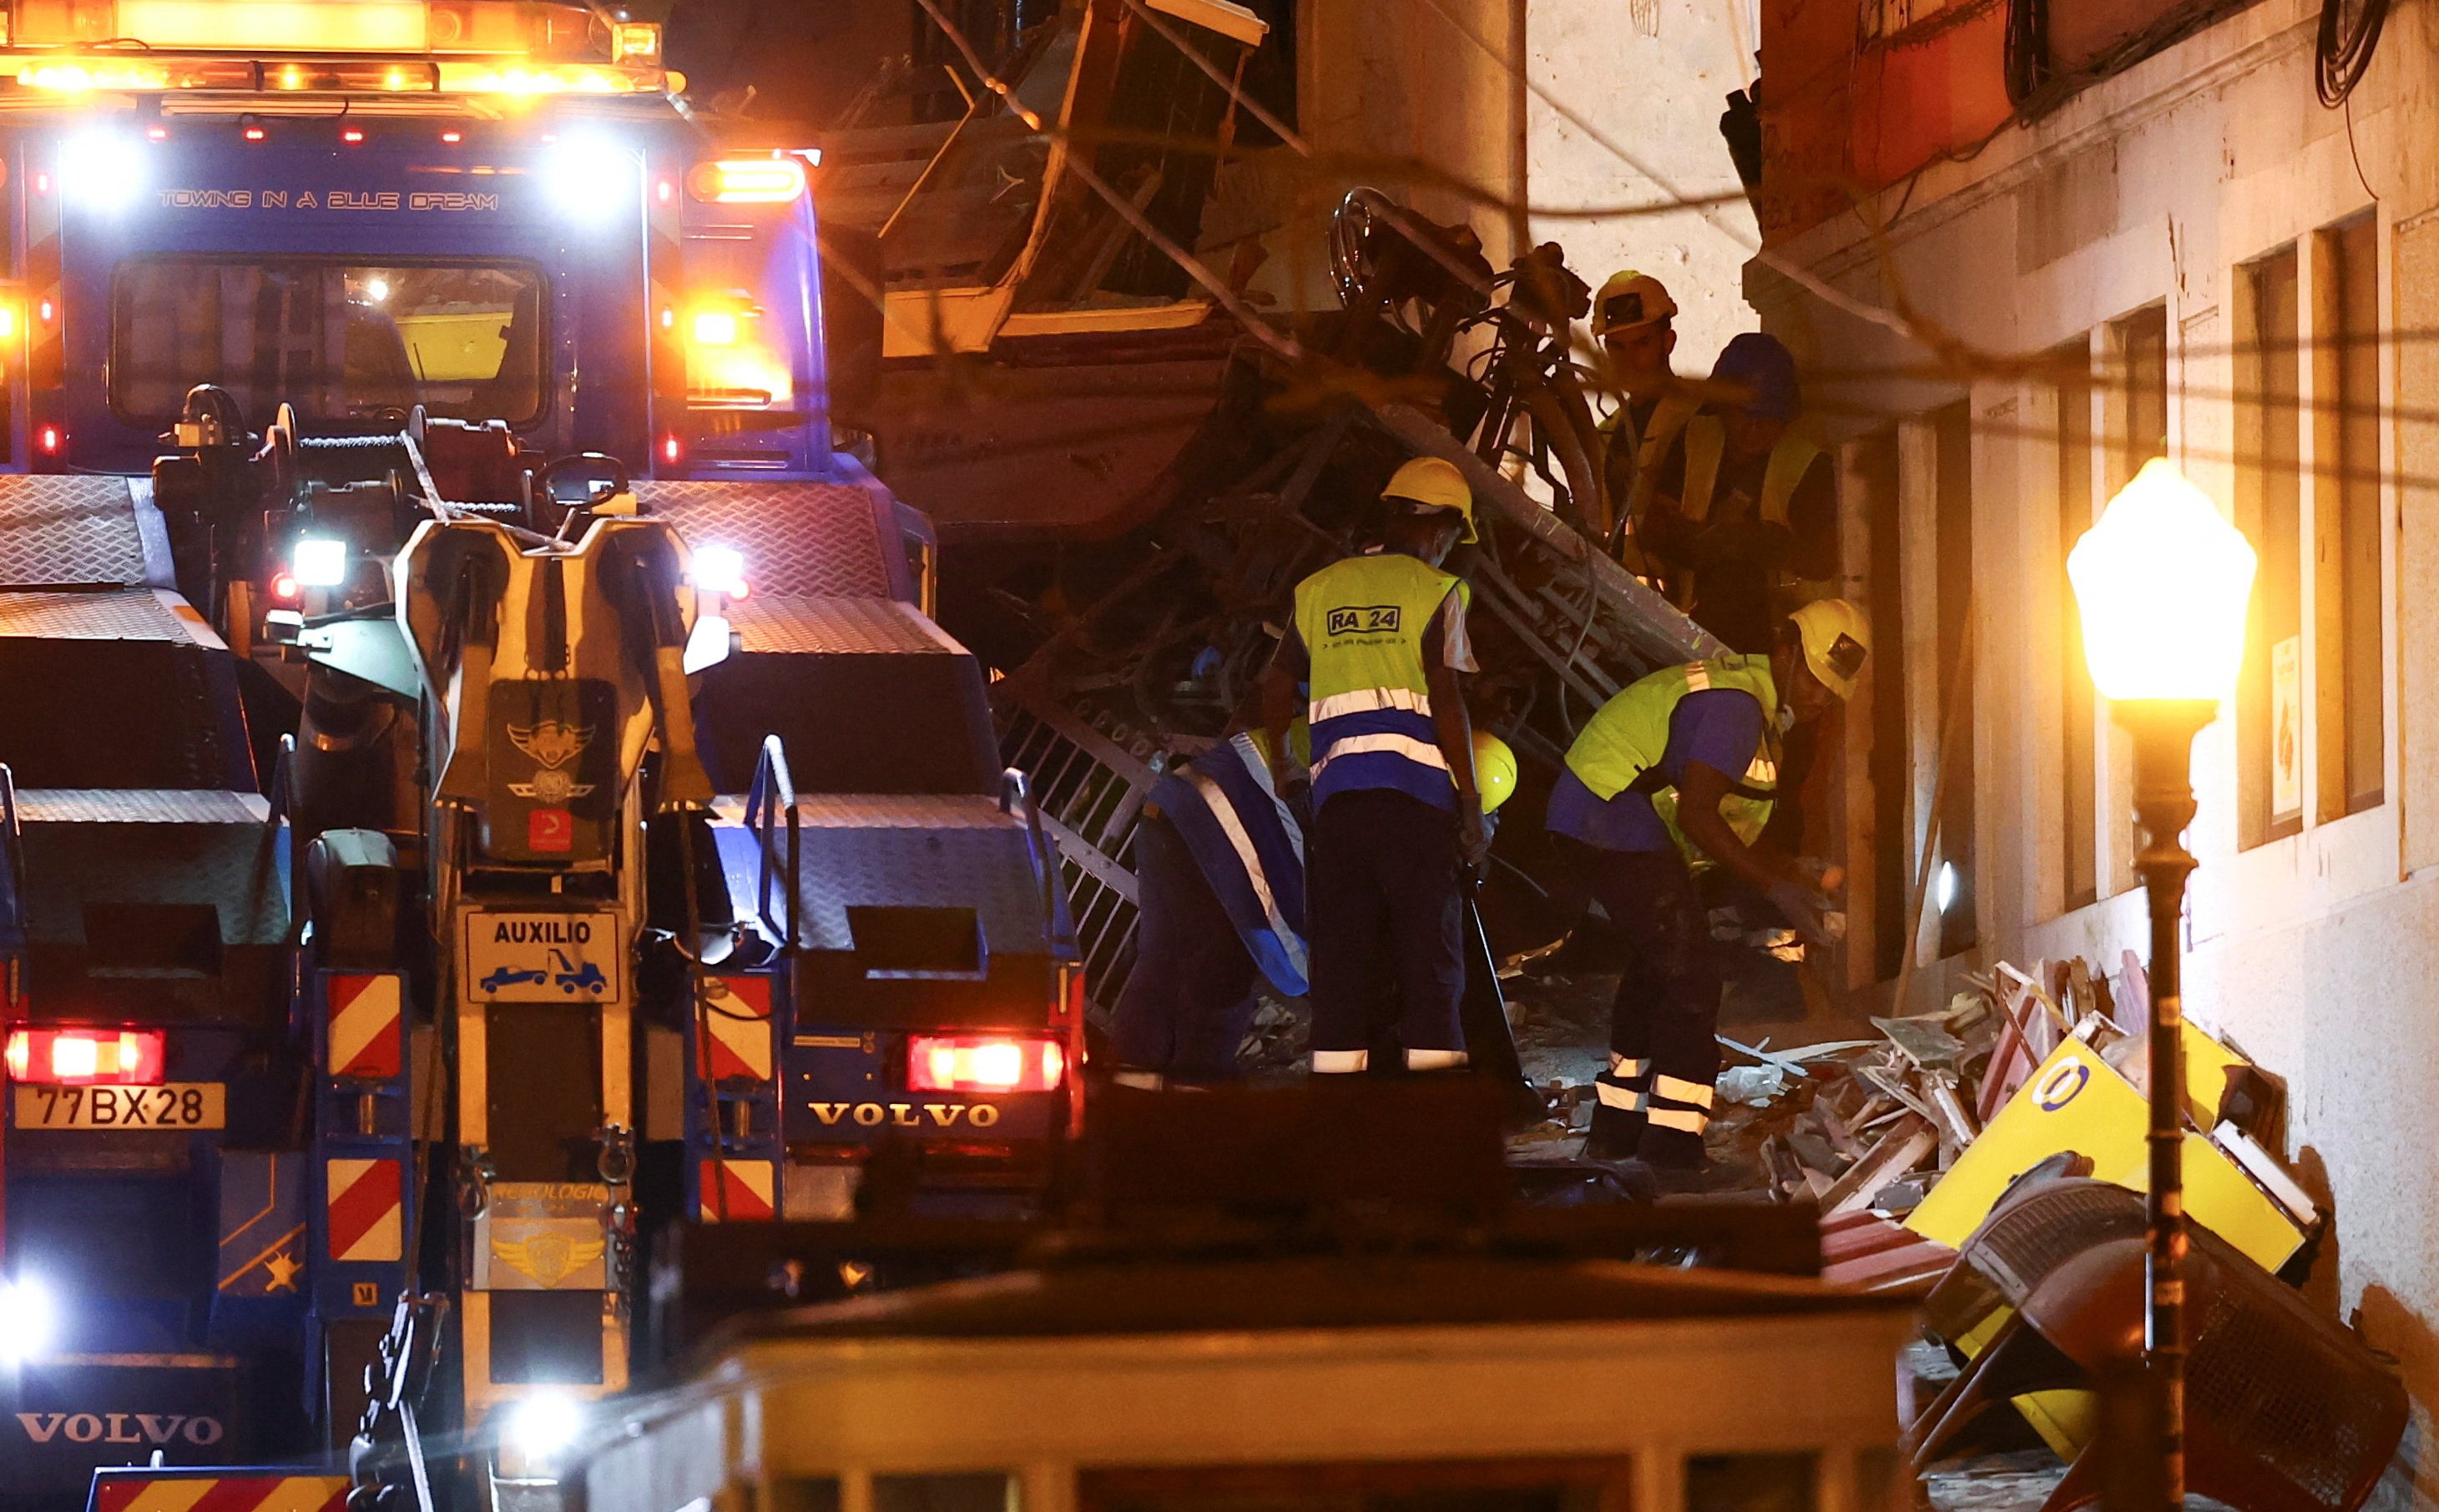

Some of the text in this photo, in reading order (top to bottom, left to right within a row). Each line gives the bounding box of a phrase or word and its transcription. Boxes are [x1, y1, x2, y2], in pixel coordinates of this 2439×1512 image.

[159, 189, 498, 210] TOWING IN A BLUE DREAM
[1331, 611, 1396, 631] RA 24
[494, 921, 591, 944] AUXILIO
[808, 1101, 1000, 1127] VOLVO
[15, 1413, 224, 1445] VOLVO
